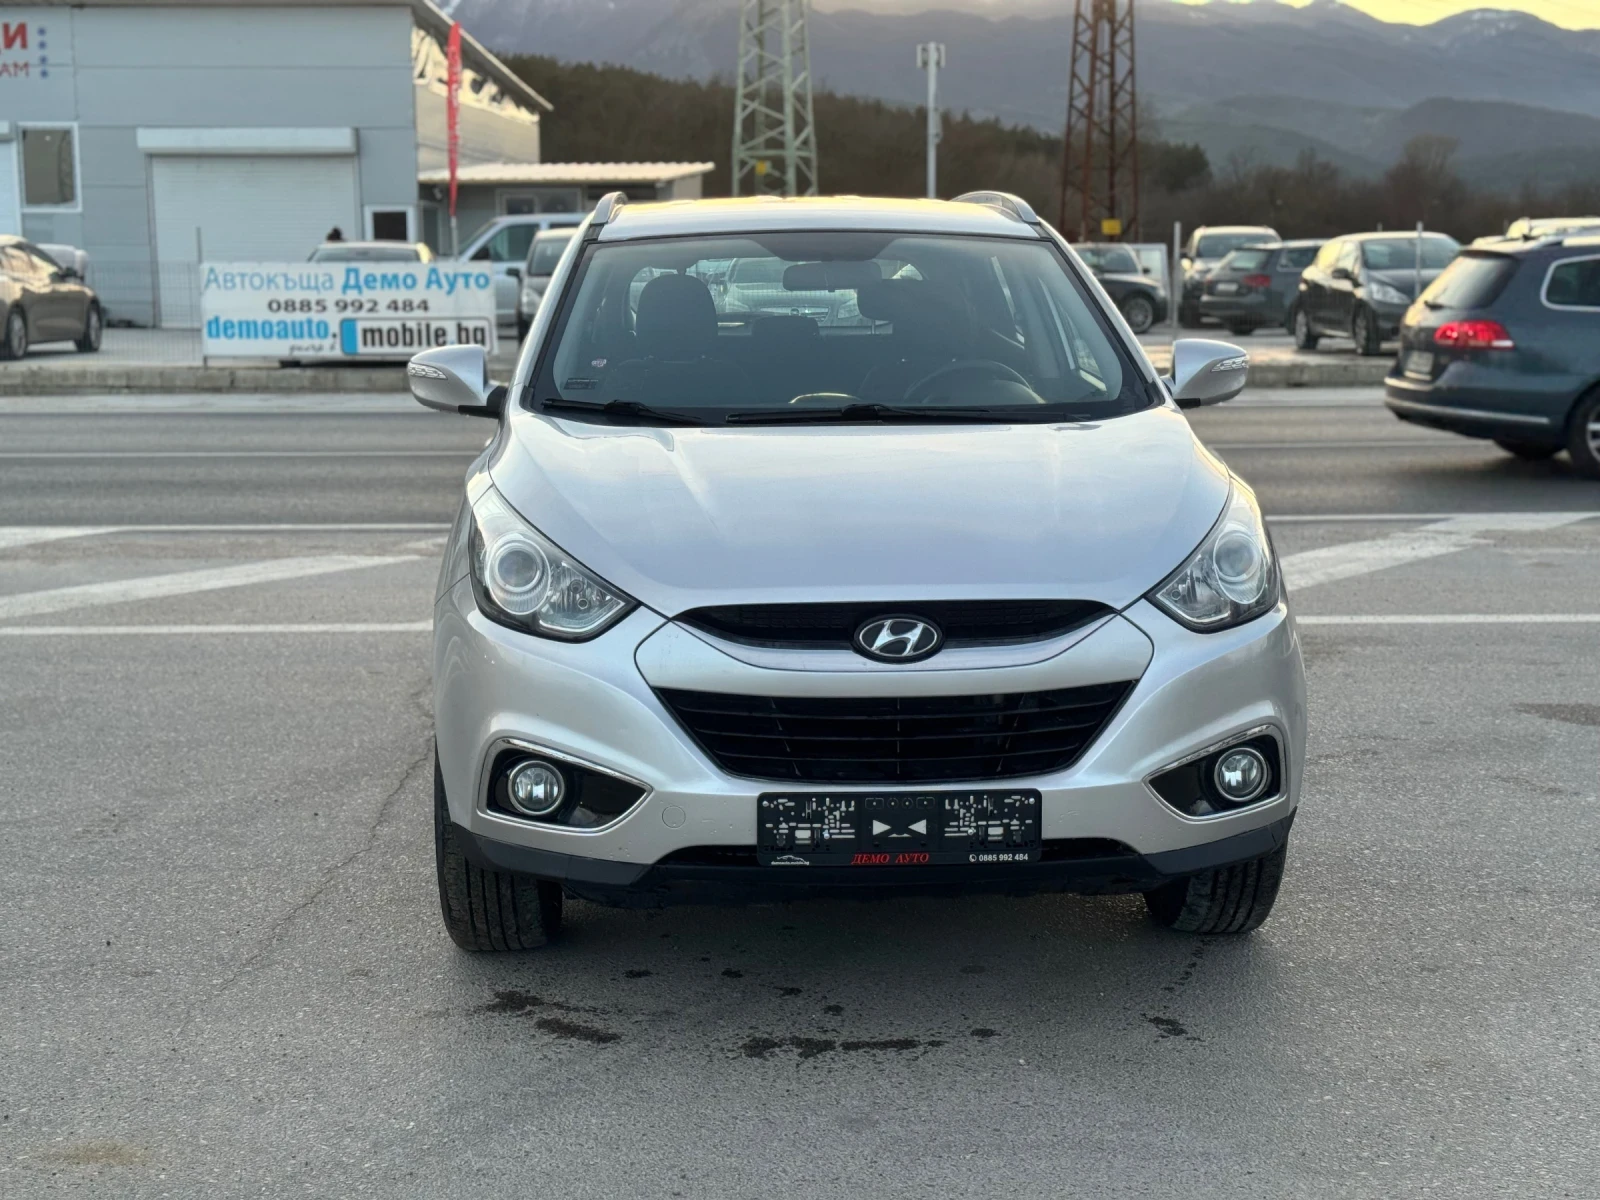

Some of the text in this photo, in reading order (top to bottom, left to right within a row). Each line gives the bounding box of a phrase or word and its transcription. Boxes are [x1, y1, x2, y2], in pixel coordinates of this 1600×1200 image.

[0, 21, 28, 51] И
[203, 267, 490, 295] Автокъща Демо Ауто
[268, 299, 430, 313] 0885 992 484
[206, 316, 486, 348] demoauto. mobile.bg
[851, 853, 930, 865] ДЕМО АУТО
[978, 854, 997, 862] 0885
